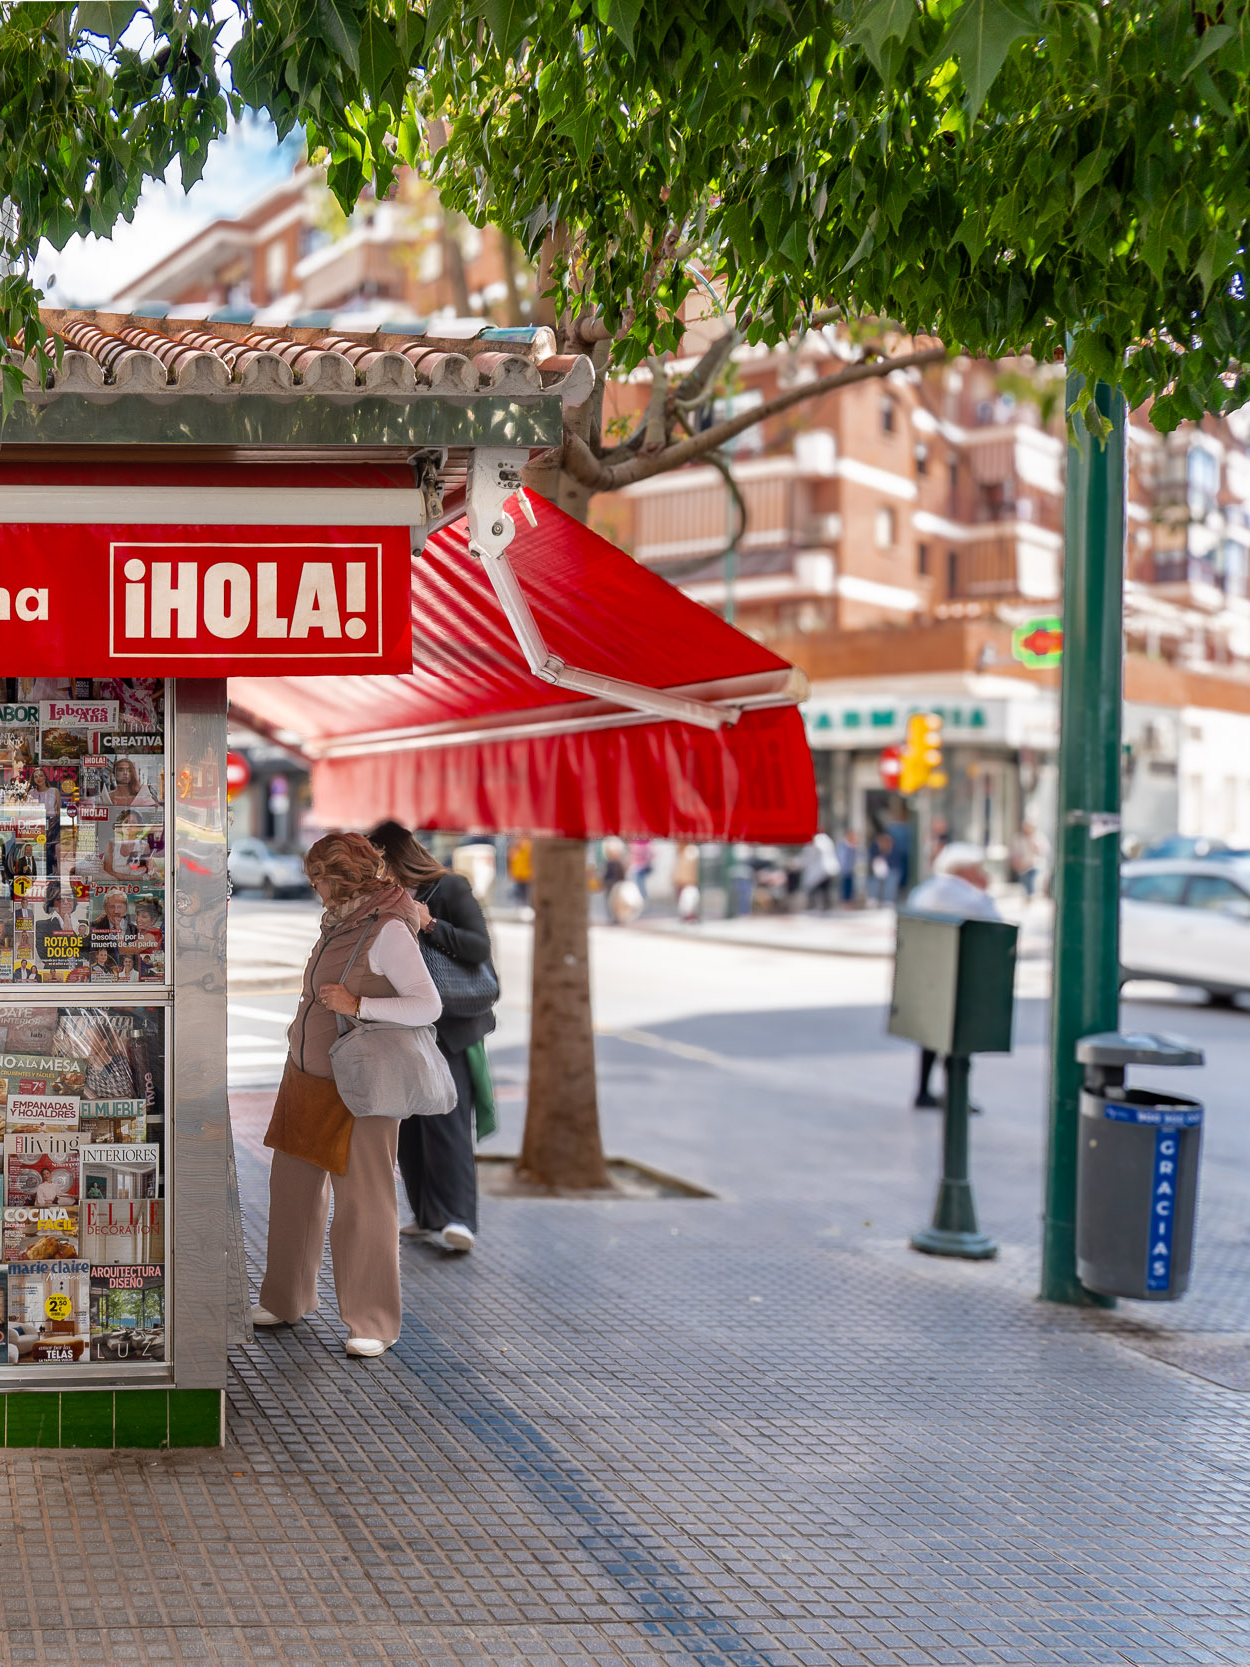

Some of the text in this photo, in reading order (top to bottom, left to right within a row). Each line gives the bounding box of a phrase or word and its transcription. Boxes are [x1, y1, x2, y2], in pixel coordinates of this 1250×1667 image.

[124, 558, 367, 640] ¡HOLA!
[48, 703, 109, 721] Labores
[77, 711, 109, 723] Ana
[103, 735, 163, 747] CREATIVA
[17, 819, 40, 830] DIEZ
[95, 883, 141, 897] pronto
[44, 937, 83, 947] ROTA DE
[91, 933, 124, 941] Desolada
[138, 941, 159, 949] padre
[46, 947, 80, 958] DOLOR
[0, 1017, 41, 1026] INTERIOR
[26, 1060, 38, 1068] LA
[39, 1059, 81, 1073] MESA
[32, 1081, 45, 1092] 7€
[12, 1100, 74, 1111] EMPANADAS
[81, 1101, 144, 1118] EL MUEBLE
[10, 1108, 76, 1119] Y HOJALDRES
[24, 1136, 80, 1154] living
[83, 1149, 157, 1162] INTERIORES
[87, 1202, 160, 1226] ELLE
[1153, 1139, 1175, 1277] GRACIAS
[3, 1207, 69, 1222] COCINA
[87, 1225, 160, 1235] DECORATION
[8, 1260, 90, 1275] marie claire
[90, 1265, 162, 1278] ARQUITECTURA
[109, 1276, 144, 1289] DISEÑO
[46, 1350, 74, 1359] TELAS
